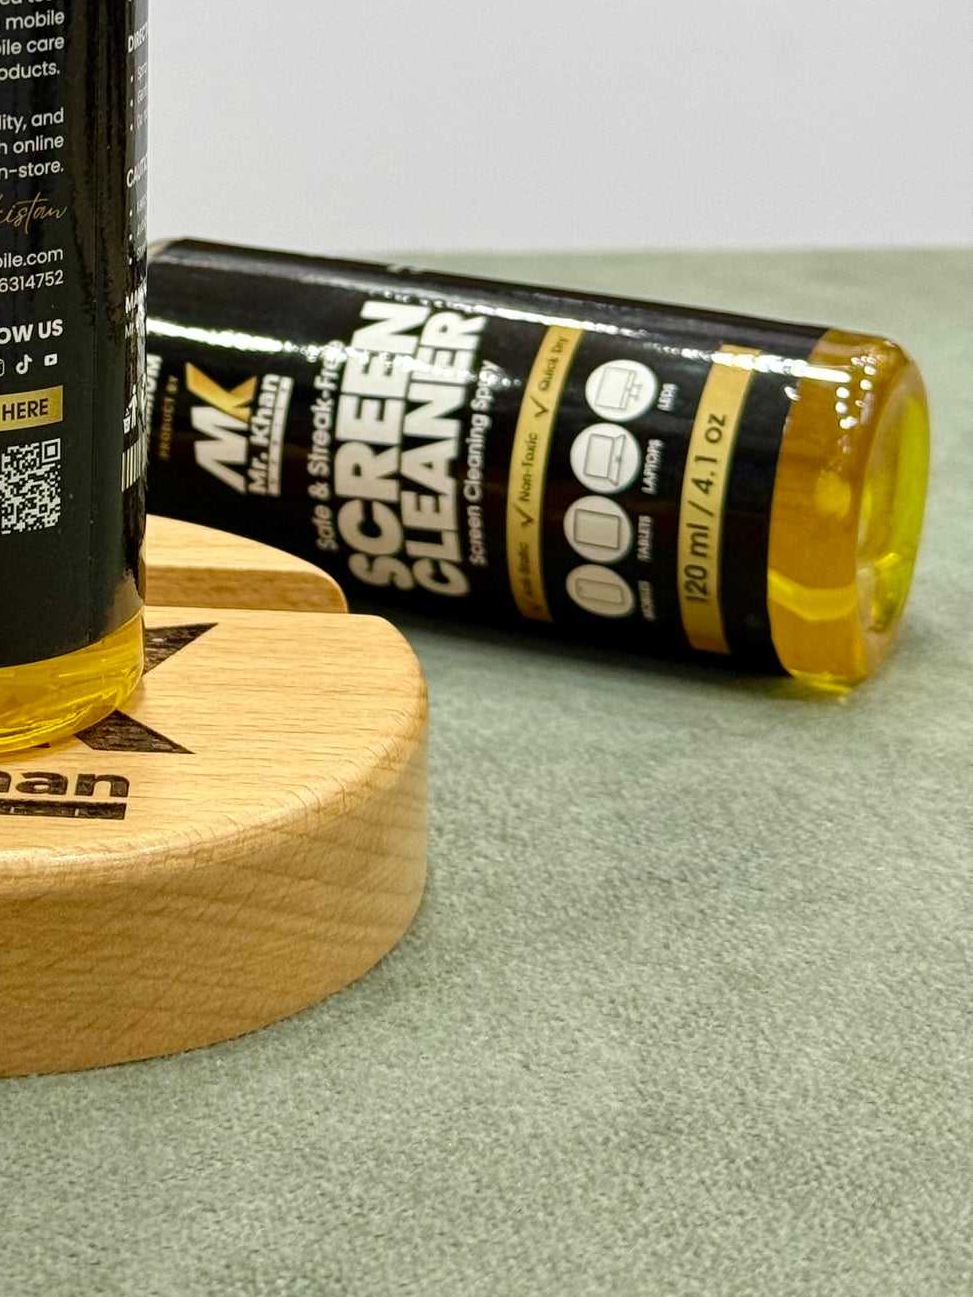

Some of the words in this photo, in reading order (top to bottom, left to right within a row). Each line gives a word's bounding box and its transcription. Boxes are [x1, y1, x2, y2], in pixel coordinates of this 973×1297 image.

[5, 10, 65, 29] mobile
[26, 35, 65, 54] care
[31, 107, 64, 127] and
[13, 133, 64, 154] online
[38, 319, 64, 339] US
[166, 375, 179, 392] BY
[2, 399, 49, 419] HERE
[249, 374, 281, 447] Khan
[521, 432, 538, 502] Non-Toxic
[538, 352, 561, 391] Quick
[705, 413, 726, 444] oz
[160, 398, 175, 460] PRODUCT
[334, 300, 430, 591] SCREEN
[247, 452, 269, 495] Mr.
[400, 311, 487, 597] CLEANER
[463, 412, 492, 502] Cleaning
[642, 439, 664, 495] LAPTOPS
[308, 483, 331, 503] &
[692, 454, 718, 495] 4.1
[311, 504, 338, 552] Safe
[688, 500, 714, 518] /
[468, 506, 488, 566] Screen
[686, 522, 711, 559] ml
[684, 563, 708, 602] 120
